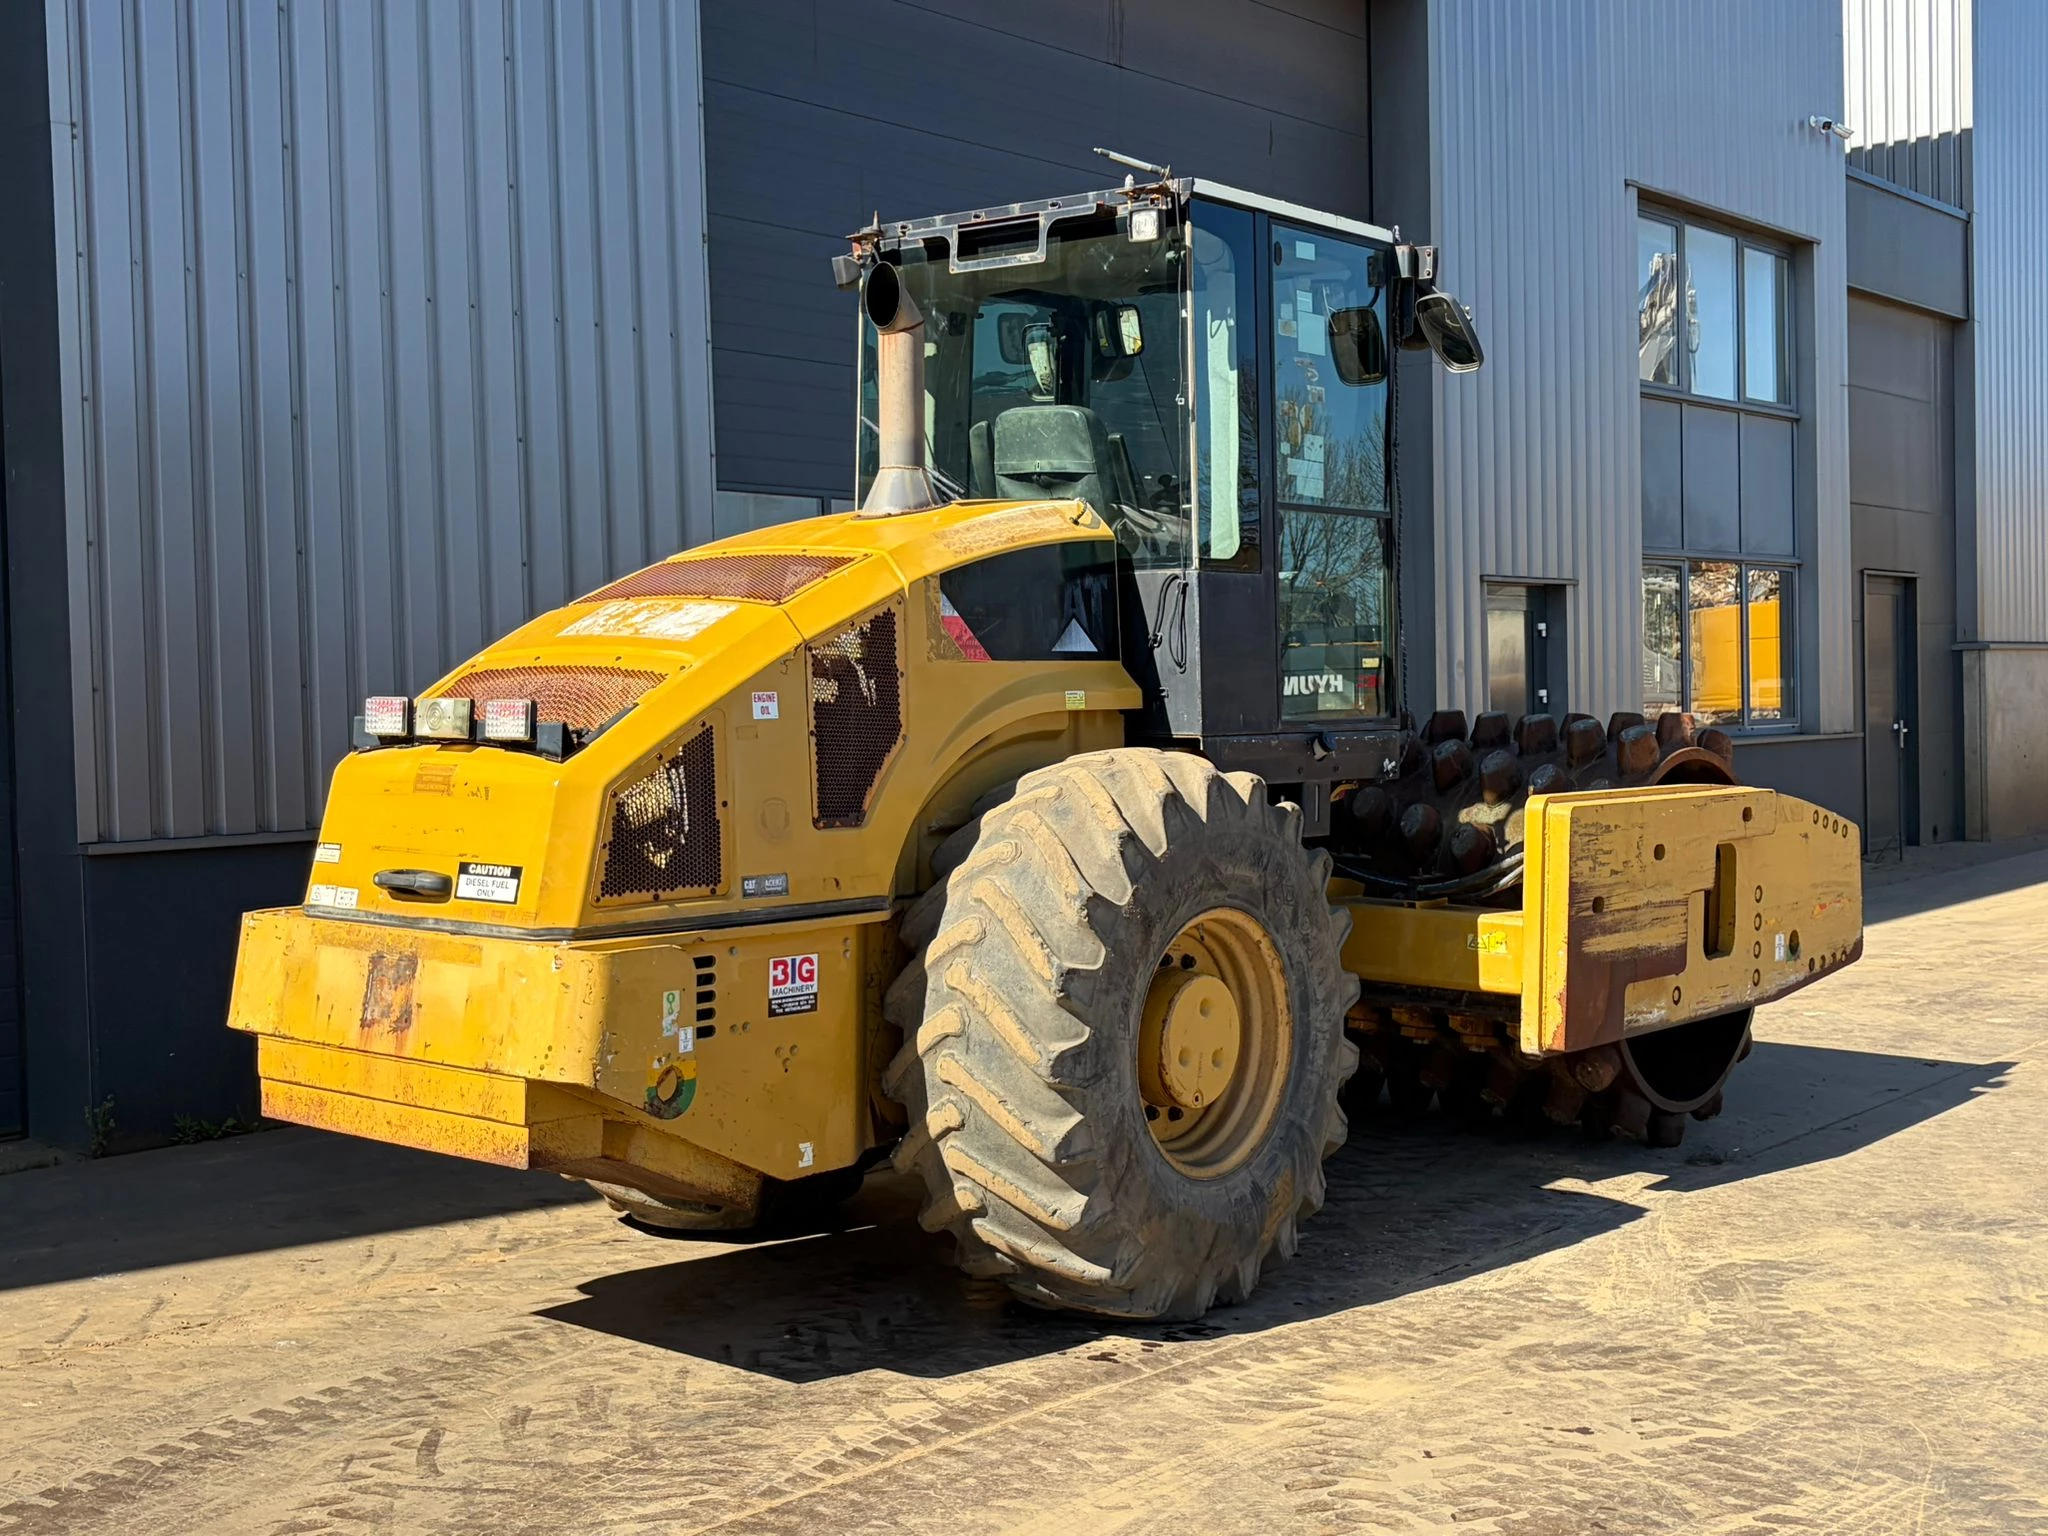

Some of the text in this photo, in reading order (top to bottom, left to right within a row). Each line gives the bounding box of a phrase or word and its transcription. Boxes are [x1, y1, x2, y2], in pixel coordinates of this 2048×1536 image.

[753, 693, 776, 703] ENGINE
[760, 705, 771, 715] OIL
[468, 864, 511, 877] CAUTION
[465, 877, 509, 889] DIESEL FUEL
[476, 888, 495, 897] ONLY
[772, 984, 815, 996] MACHINERY
